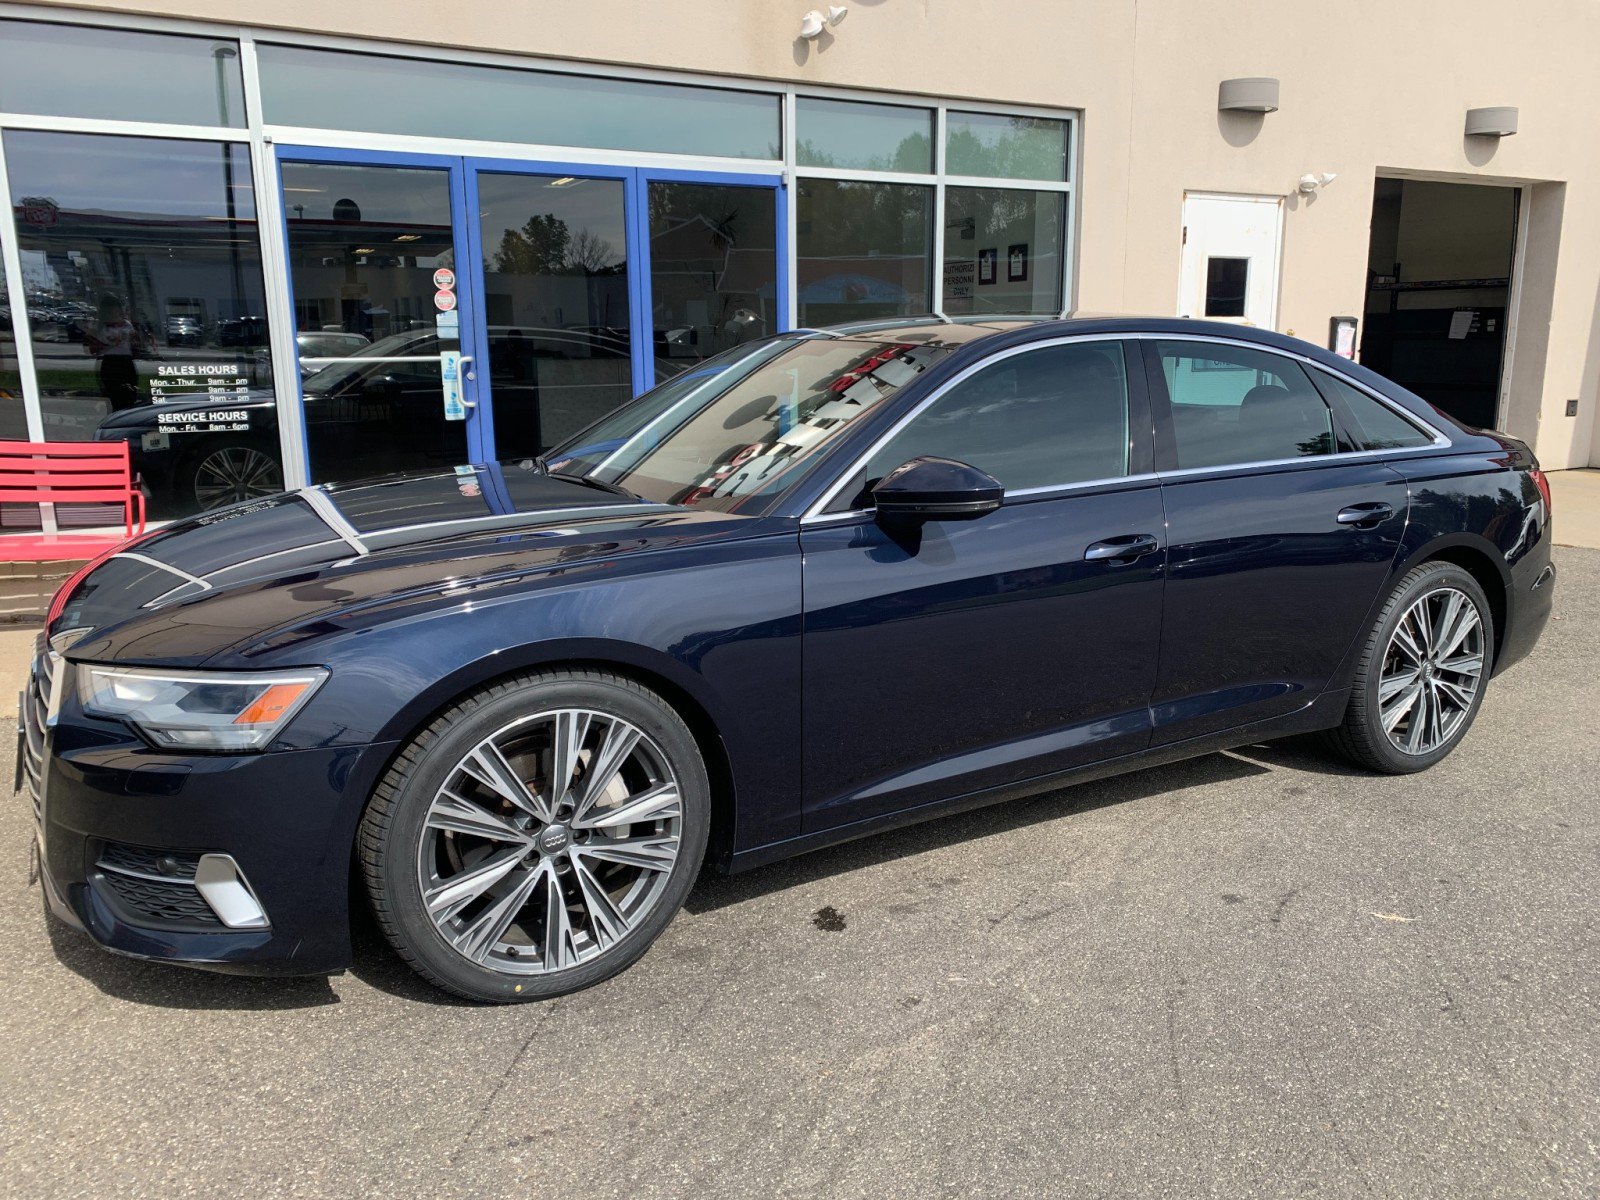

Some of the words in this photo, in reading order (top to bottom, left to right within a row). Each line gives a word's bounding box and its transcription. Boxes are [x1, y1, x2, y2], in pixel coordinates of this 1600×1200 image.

[158, 365, 195, 375] SALES
[198, 364, 238, 374] HOURS
[150, 387, 164, 395] Fri.
[158, 412, 206, 422] SERVICE
[208, 411, 248, 421] HOURS
[158, 425, 179, 433] Mon.
[209, 423, 226, 431] 8am
[232, 422, 250, 431] 6pm
